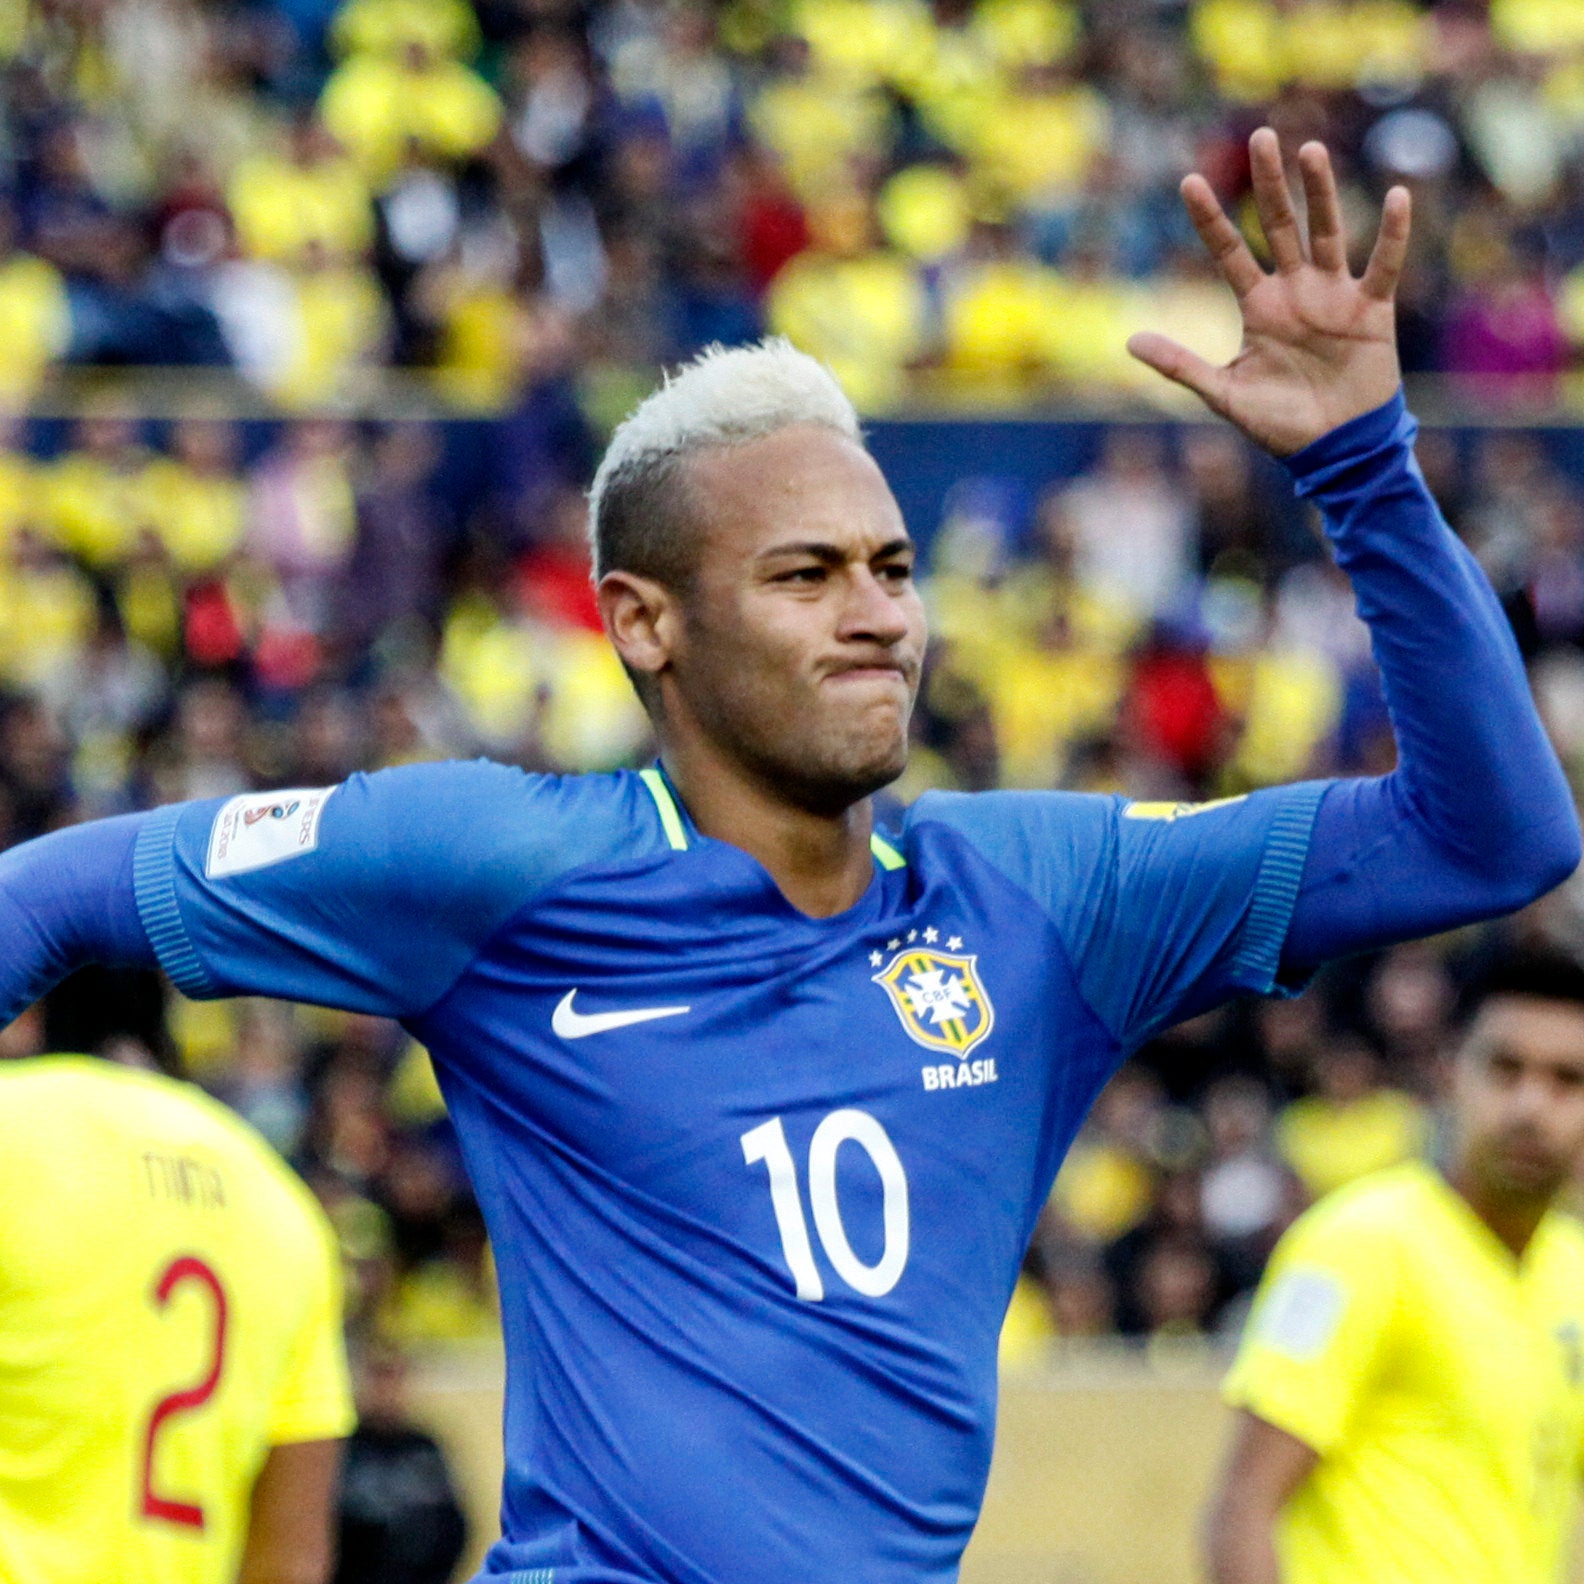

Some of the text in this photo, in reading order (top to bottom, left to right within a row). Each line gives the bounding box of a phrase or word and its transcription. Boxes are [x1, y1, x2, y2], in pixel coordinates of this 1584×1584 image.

[921, 987, 953, 1004] CBF
[921, 1057, 999, 1092] BRASIL
[739, 1108, 910, 1302] 10
[136, 1254, 230, 1532] 2
